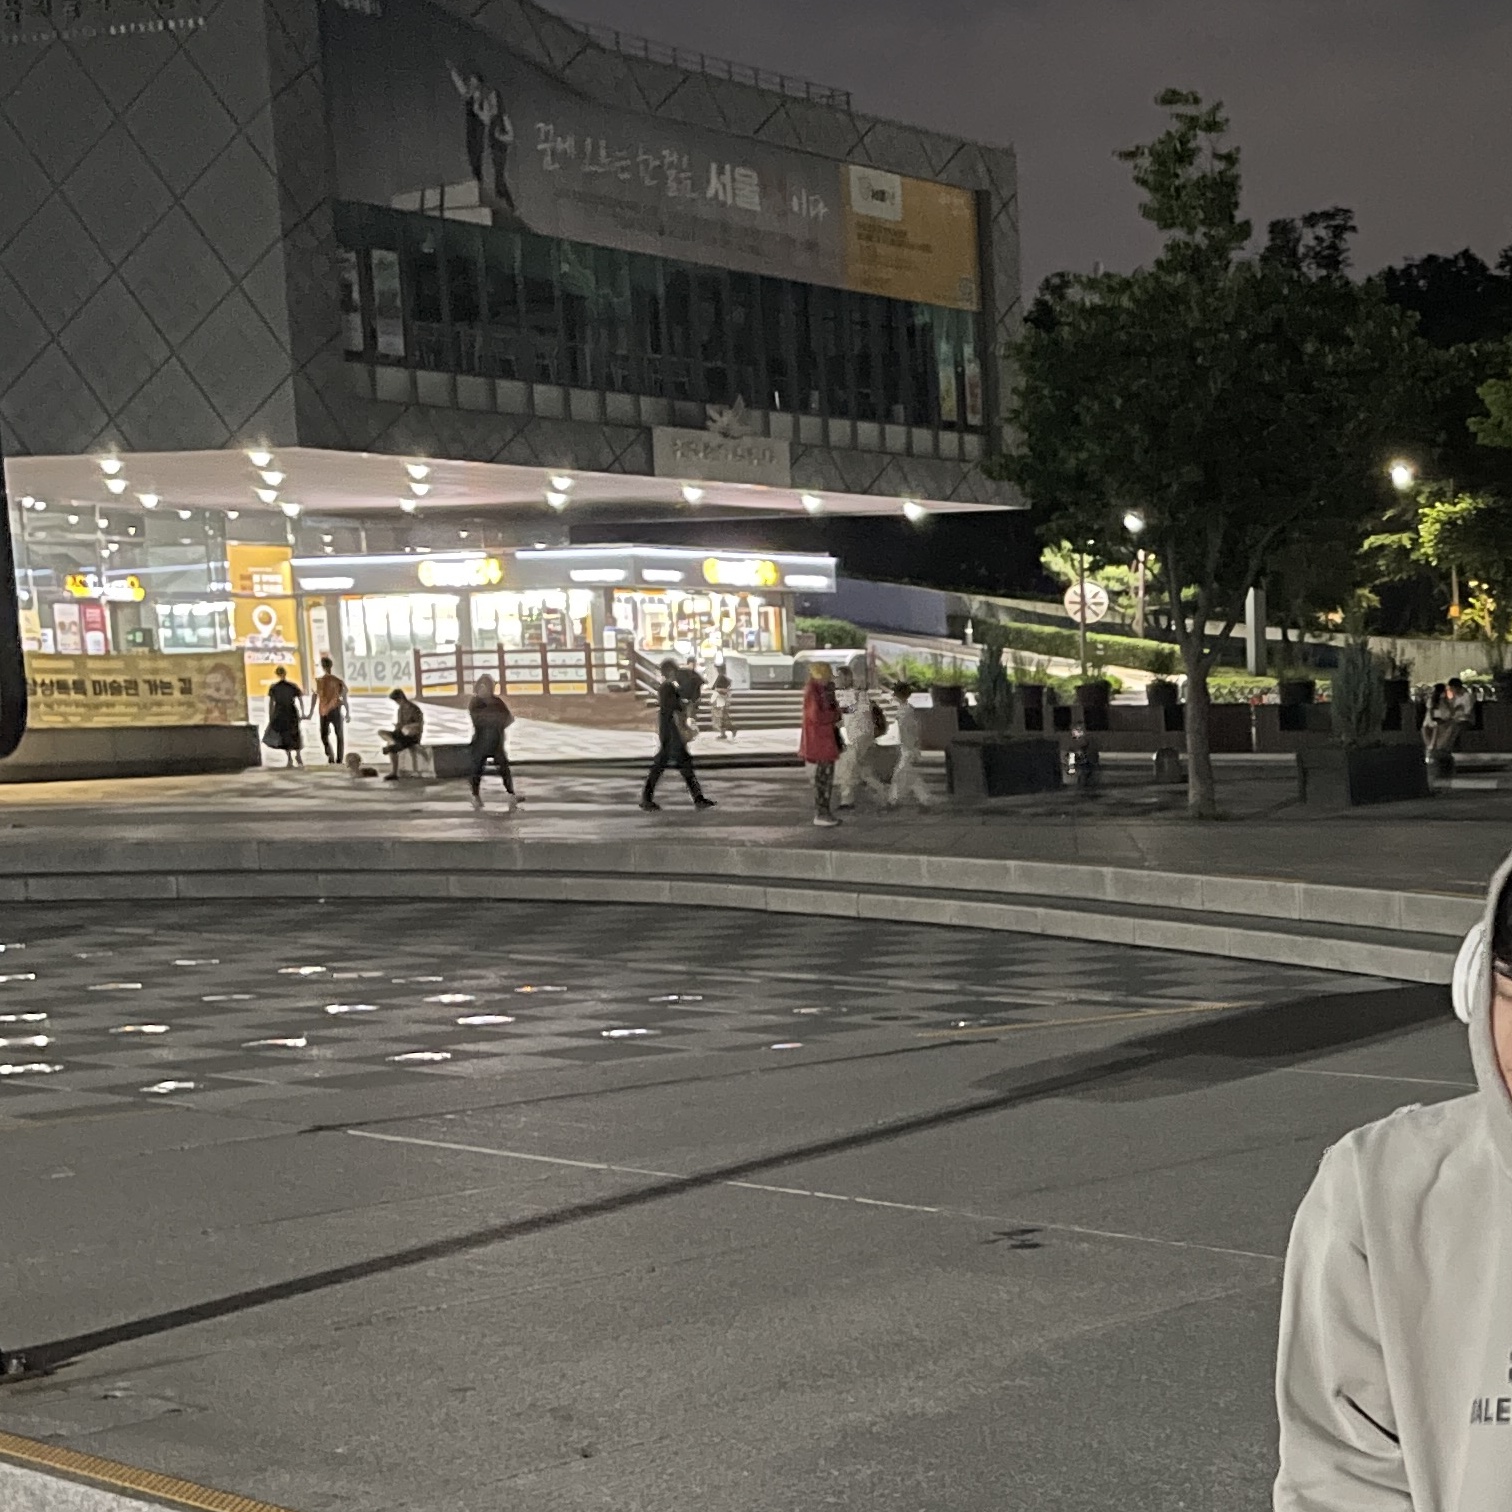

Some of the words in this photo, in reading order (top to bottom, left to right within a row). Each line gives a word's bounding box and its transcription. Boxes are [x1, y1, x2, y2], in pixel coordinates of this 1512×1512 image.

[705, 161, 762, 211] 서울
[791, 187, 830, 222] 이다
[347, 661, 368, 681] 24
[374, 660, 386, 681] e
[391, 660, 412, 681] 24
[92, 677, 139, 696] 미술관
[143, 677, 173, 695] 가는
